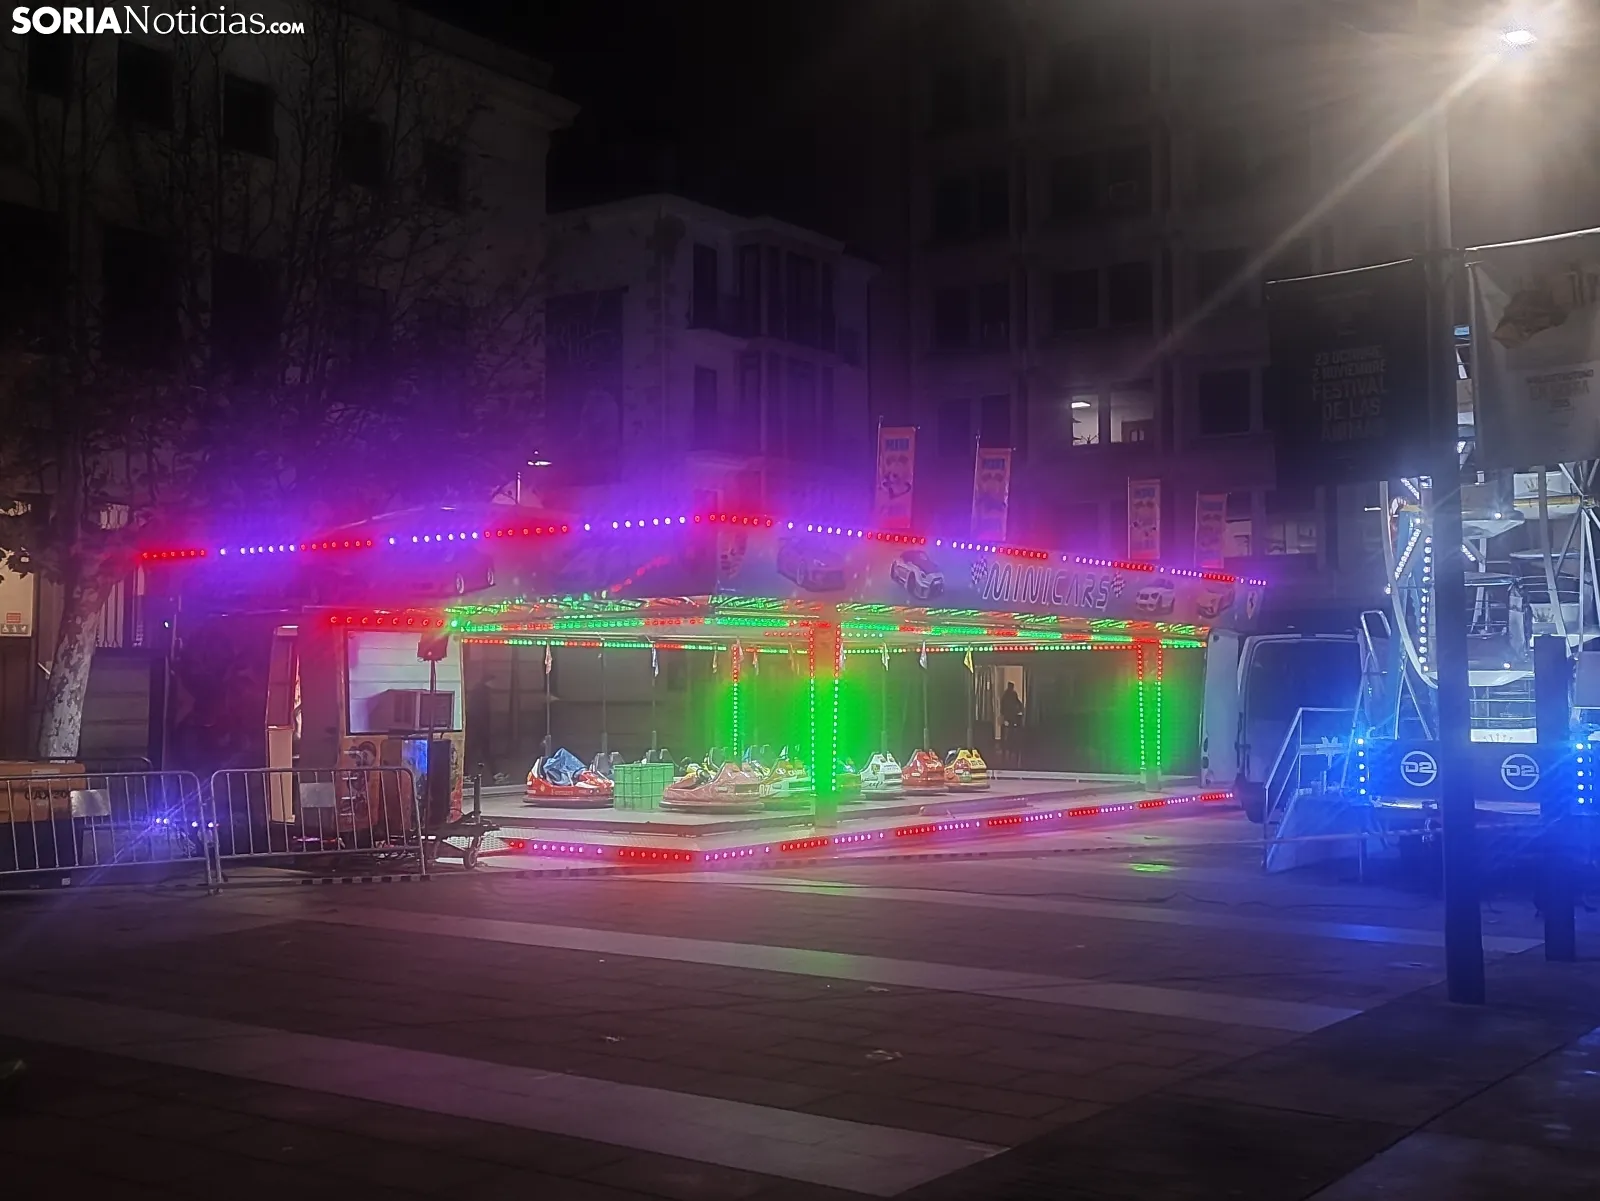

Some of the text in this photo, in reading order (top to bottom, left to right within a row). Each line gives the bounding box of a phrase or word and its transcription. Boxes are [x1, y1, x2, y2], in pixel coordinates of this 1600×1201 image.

[1311, 374, 1390, 402] FESTIVAL
[1323, 397, 1381, 421] DE LAS
[982, 561, 1111, 611] MINICARS
